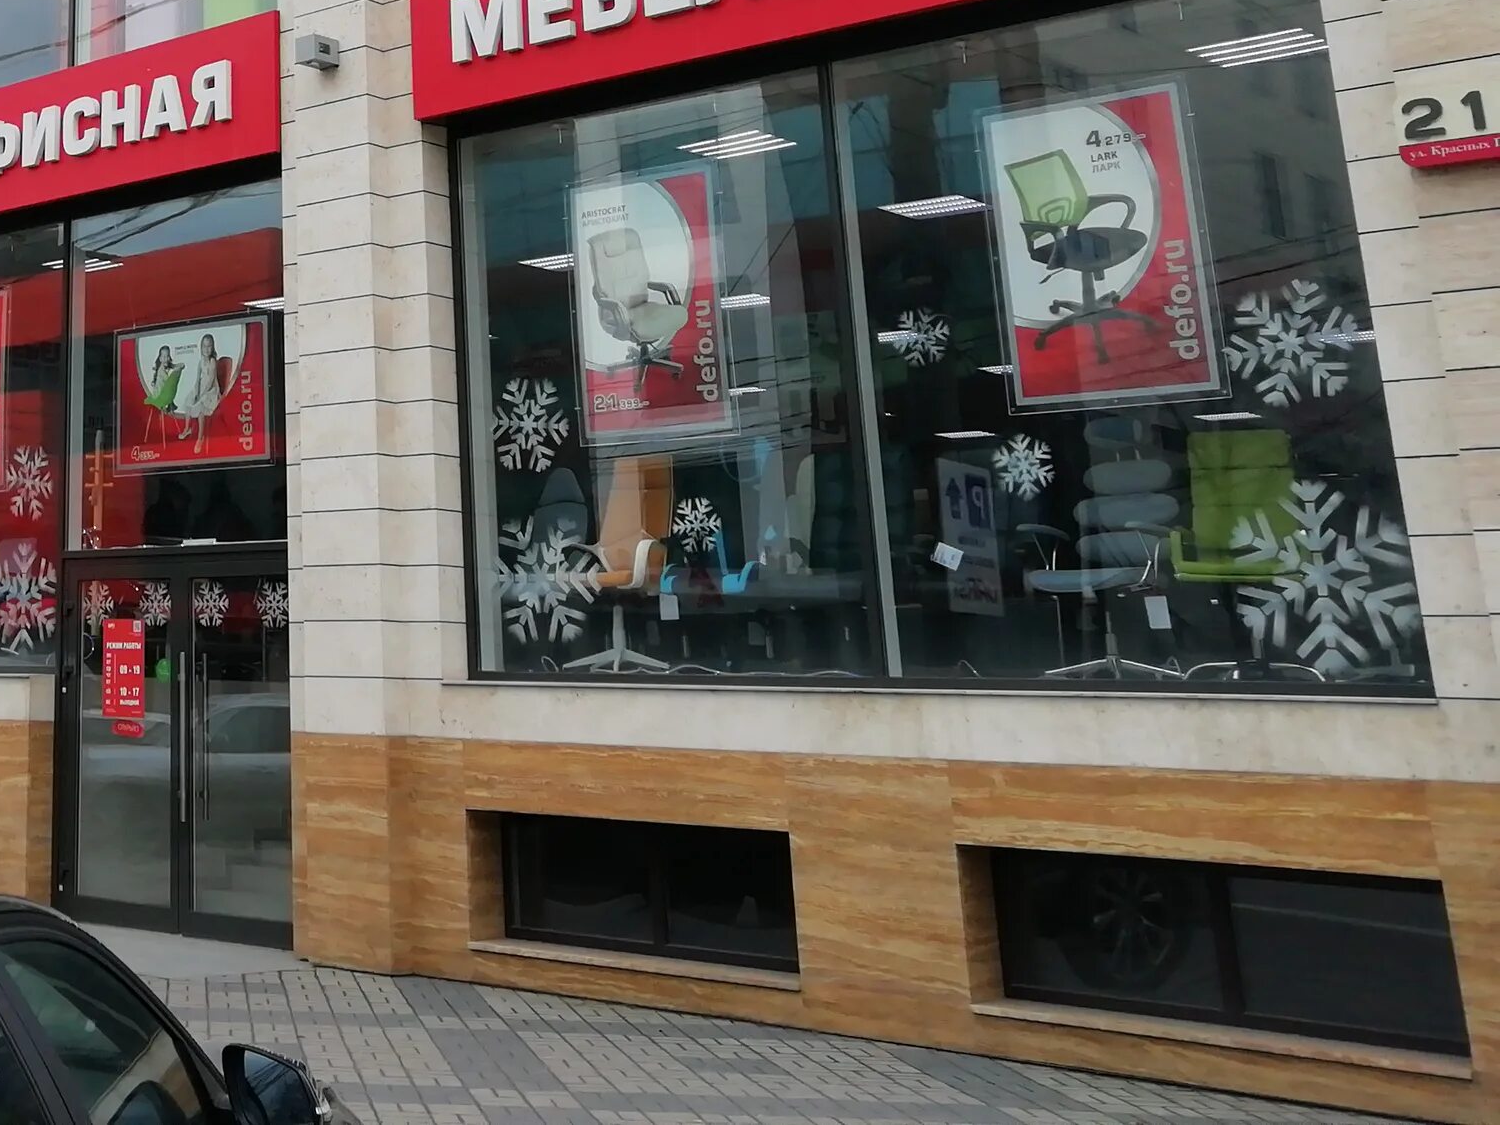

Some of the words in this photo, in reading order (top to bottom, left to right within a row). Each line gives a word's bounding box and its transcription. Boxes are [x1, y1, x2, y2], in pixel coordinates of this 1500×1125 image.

[1090, 151, 1118, 163] LARK
[1430, 140, 1491, 158] Красных
[581, 204, 626, 220] ARISTOCRAT
[1164, 239, 1201, 361] defo.ru
[695, 300, 719, 402] defo.ru
[237, 370, 253, 451] defo.ru
